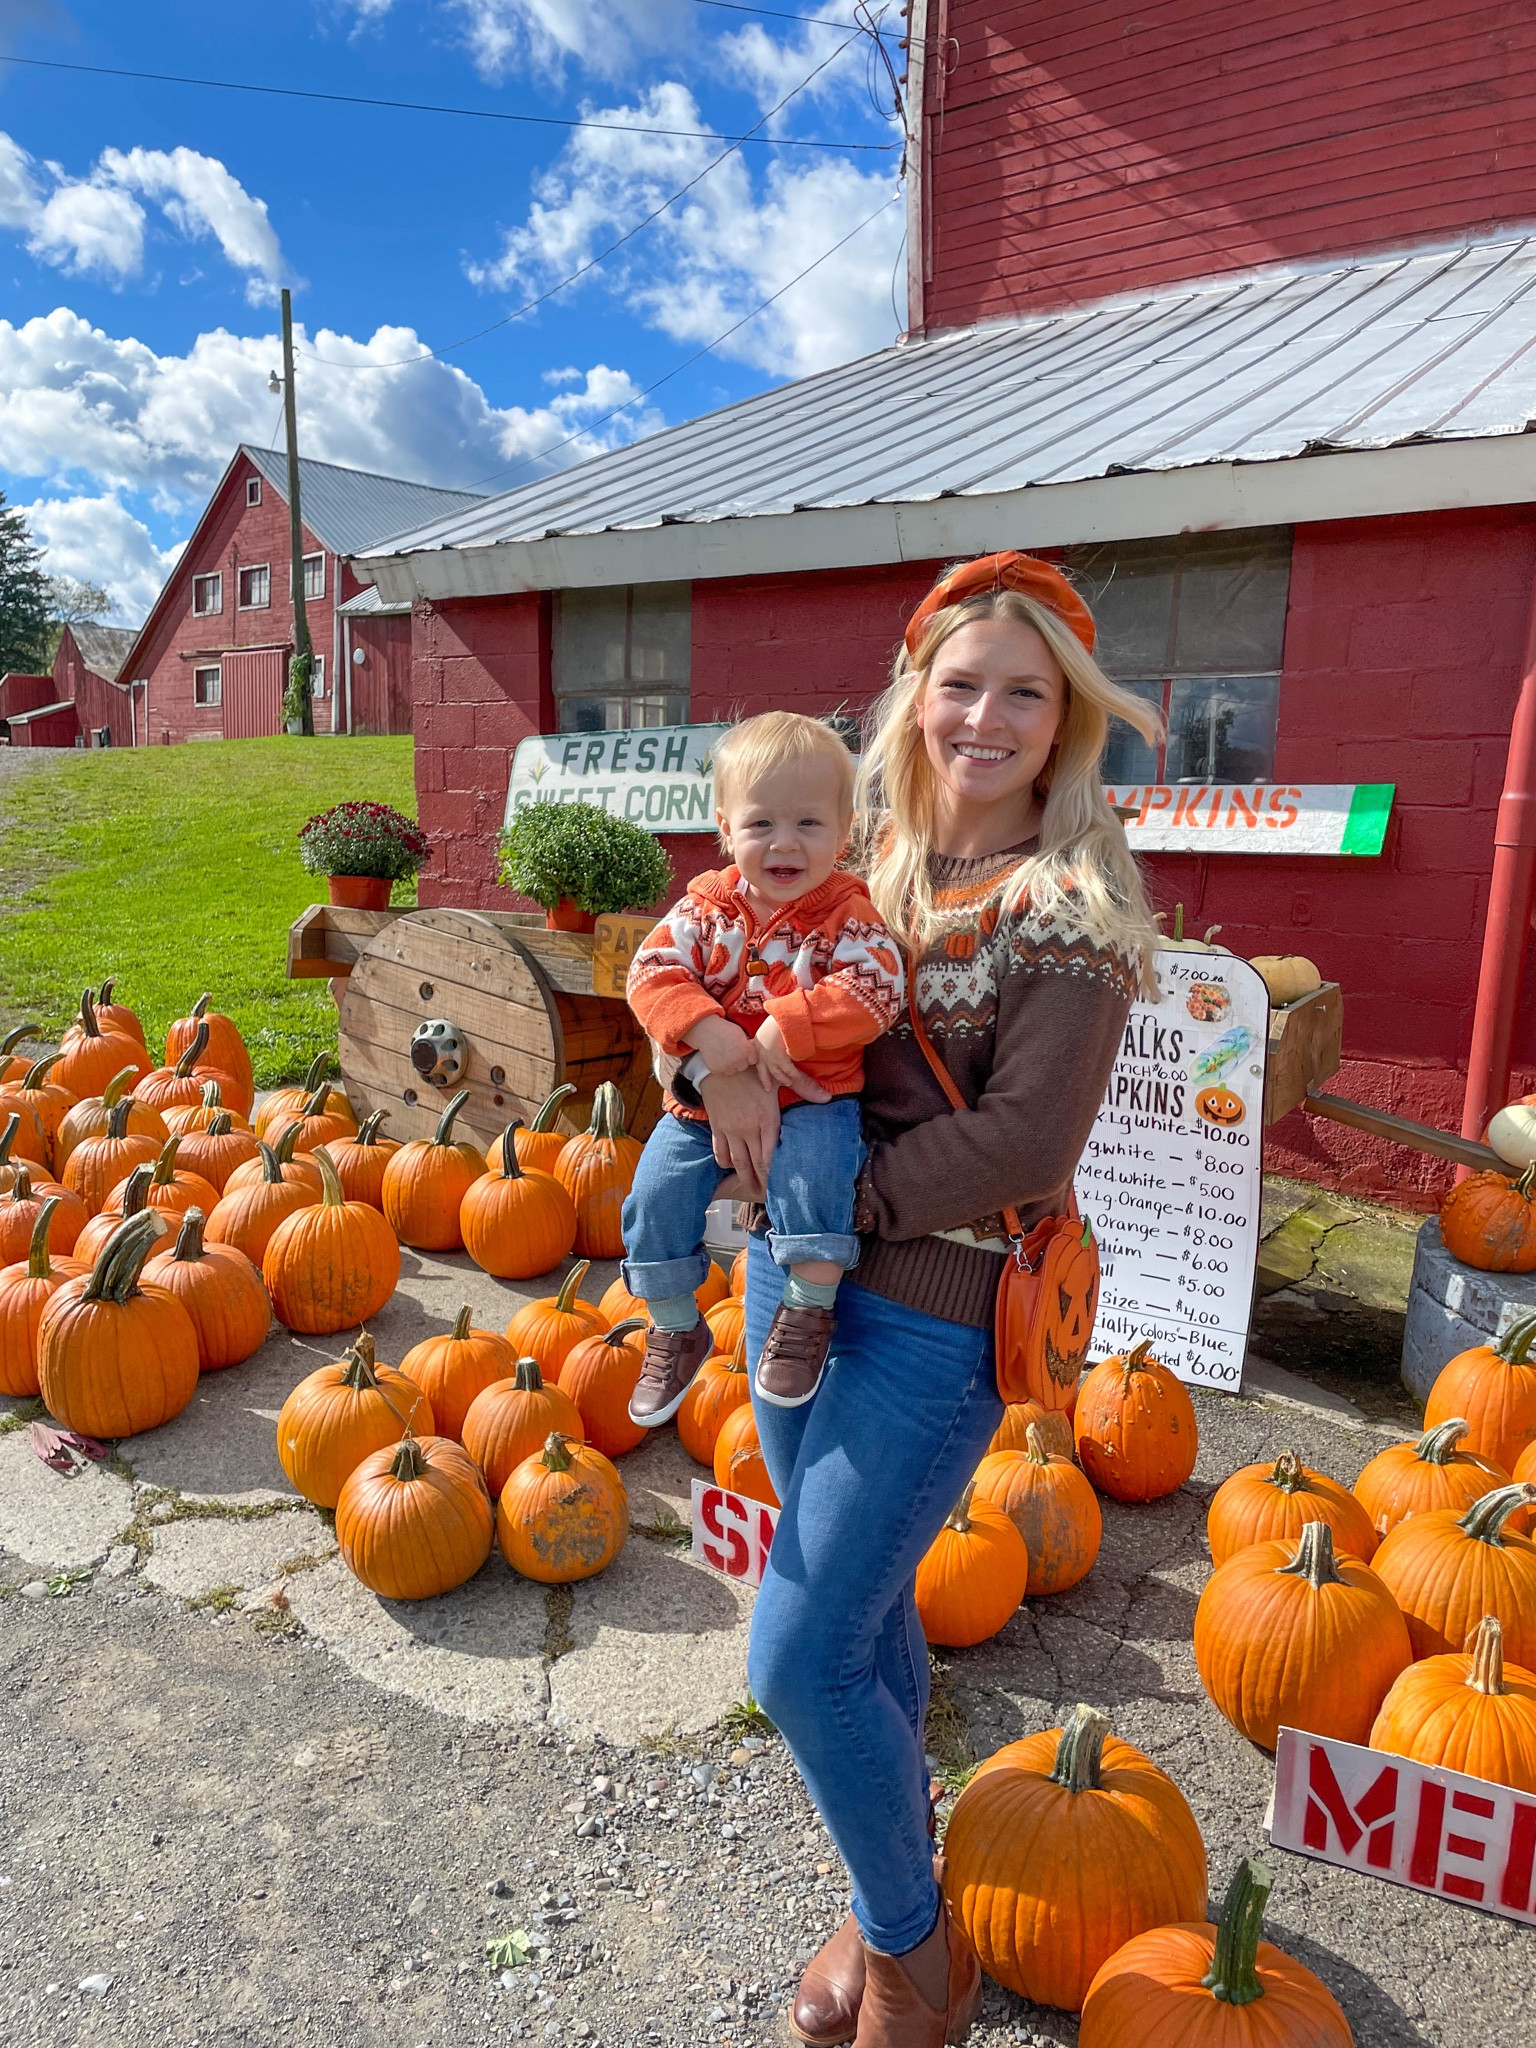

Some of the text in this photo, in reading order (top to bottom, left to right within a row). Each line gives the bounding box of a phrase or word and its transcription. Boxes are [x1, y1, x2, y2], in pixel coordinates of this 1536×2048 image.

[560, 736, 688, 776] FRESH
[625, 783, 711, 823] CORN
[1194, 1150, 1245, 1176] $8.00
[1189, 1175, 1235, 1201] $5.00
[1096, 1213, 1160, 1242] Orange
[1184, 1225, 1233, 1249] $8.00
[1181, 1249, 1228, 1273] $6.00
[1178, 1275, 1225, 1298] $5.00
[1175, 1298, 1220, 1325] $4.00
